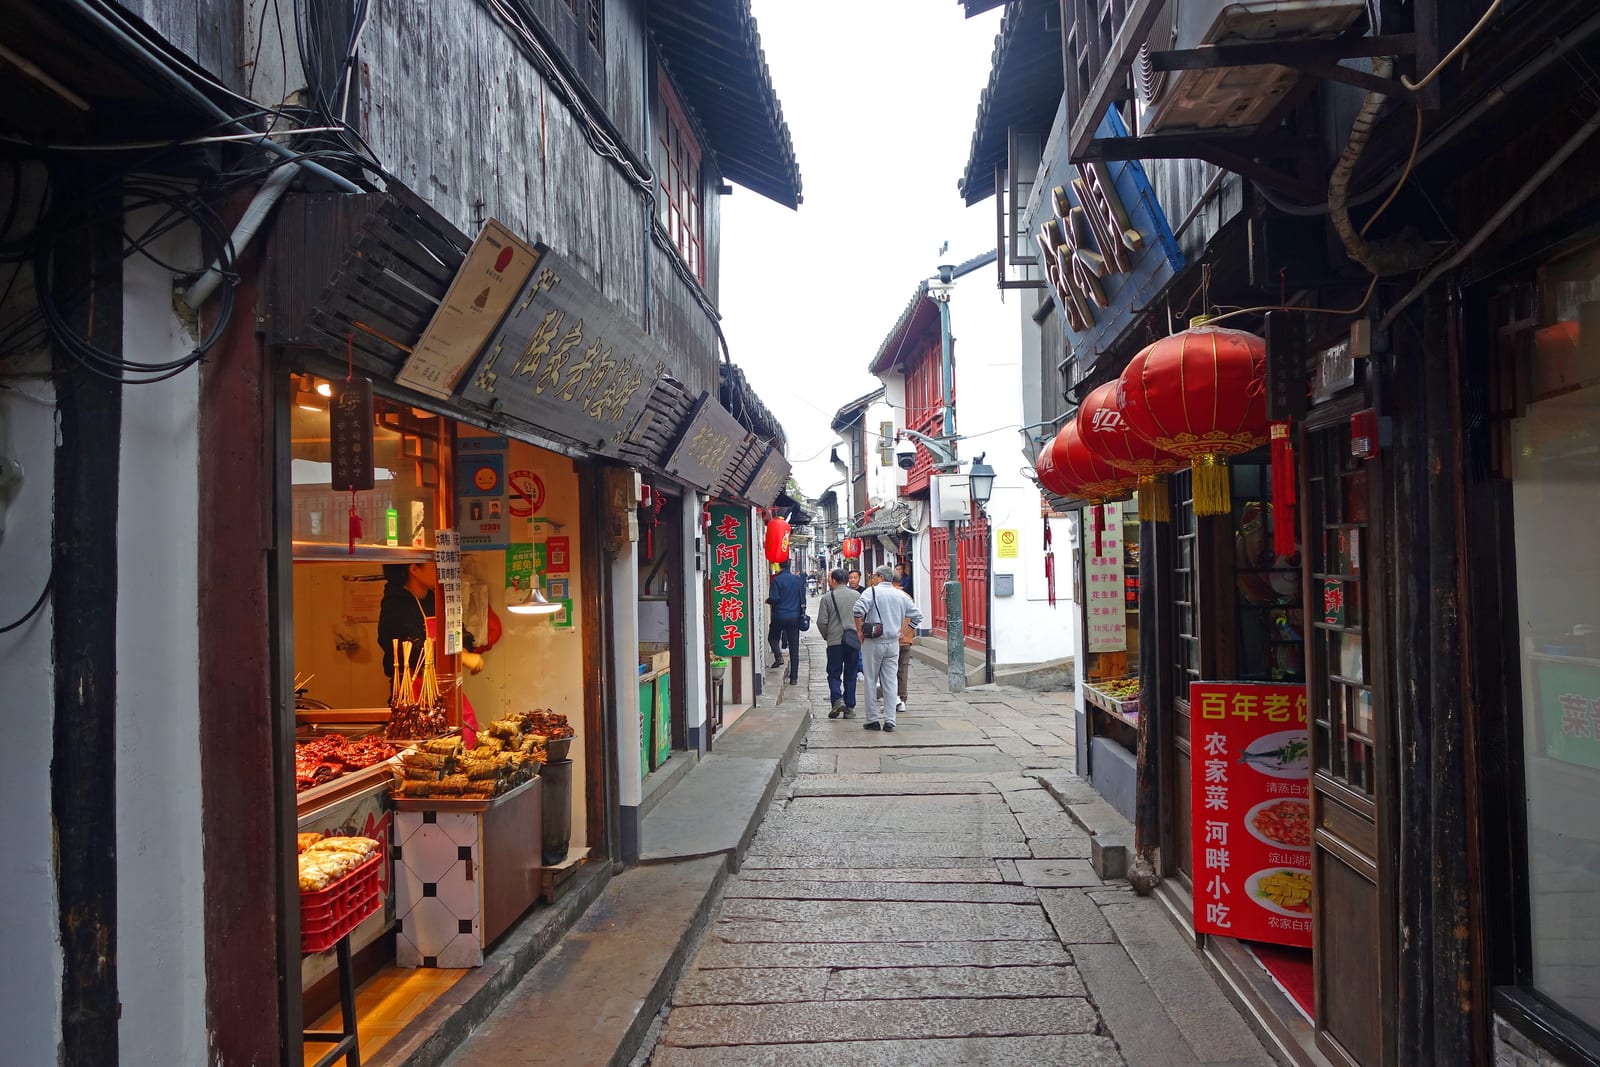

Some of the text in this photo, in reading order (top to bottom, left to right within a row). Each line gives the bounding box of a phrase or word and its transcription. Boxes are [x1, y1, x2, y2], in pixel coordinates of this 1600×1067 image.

[715, 514, 744, 650] 老阿婆粽子
